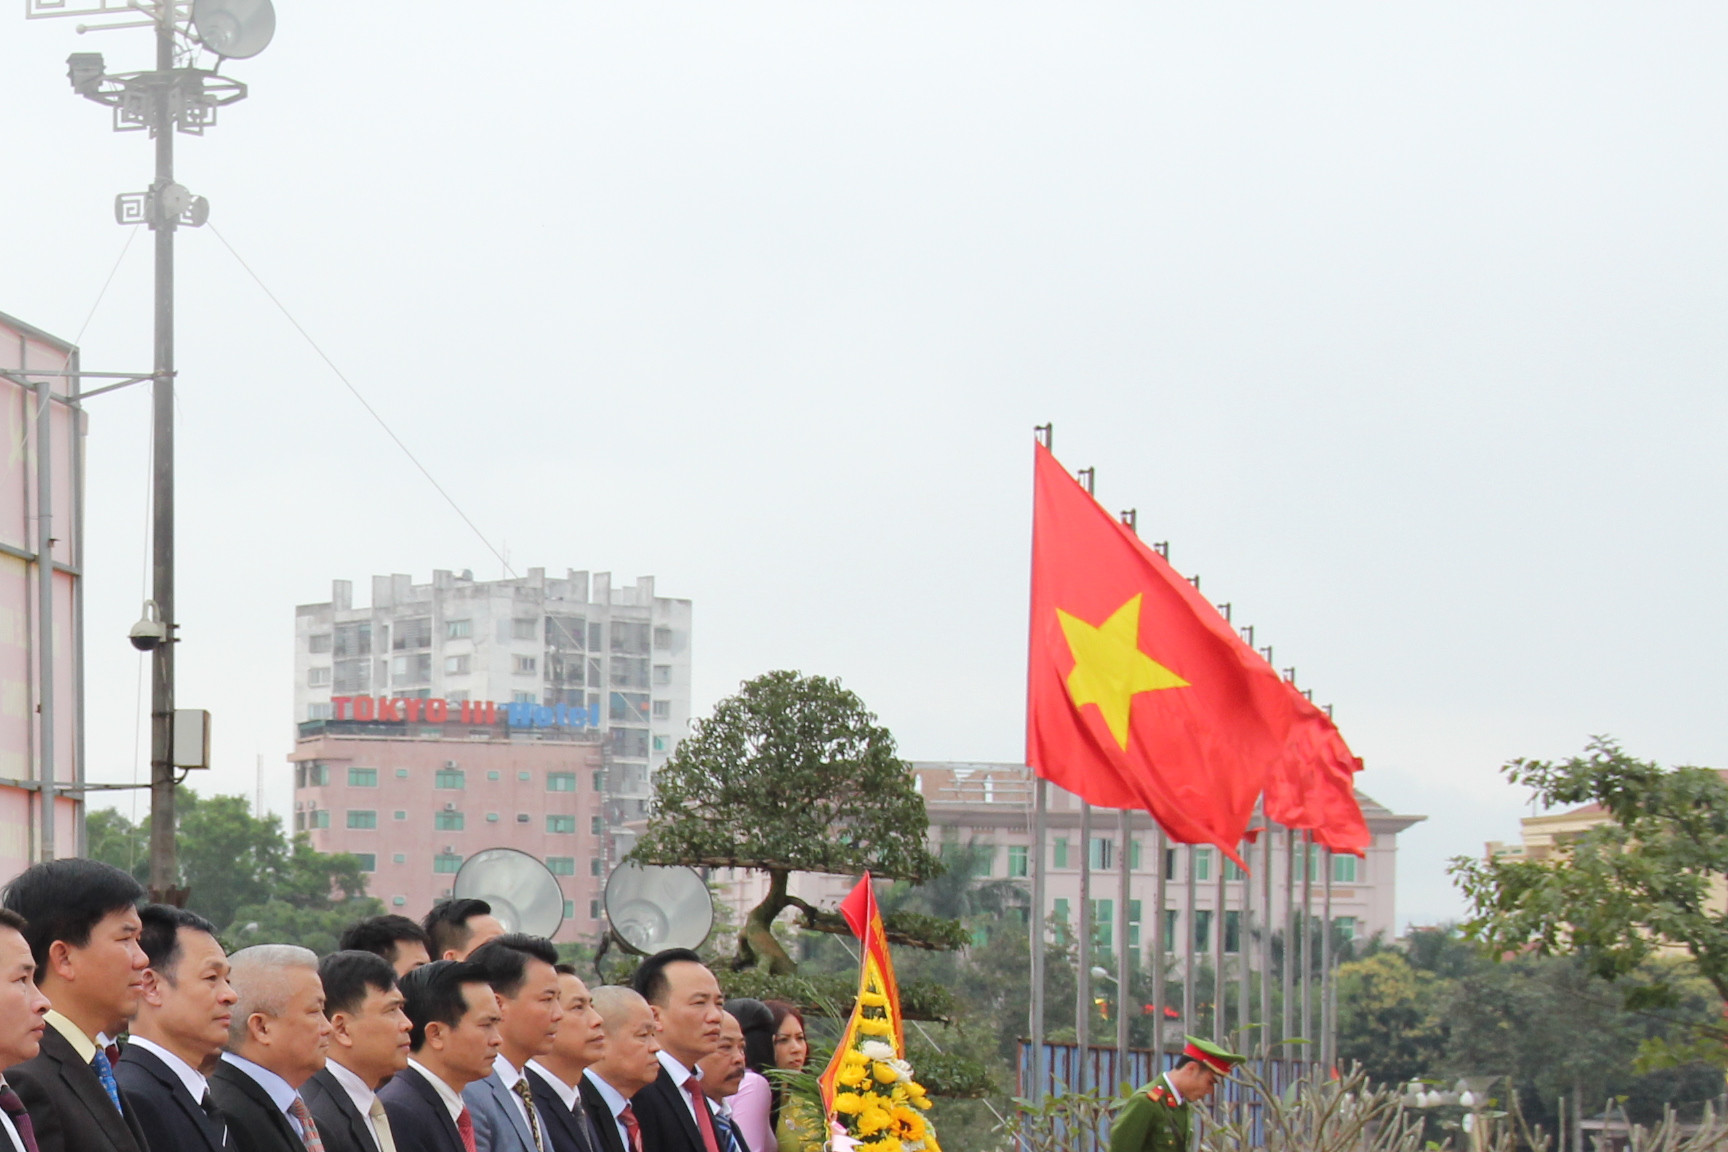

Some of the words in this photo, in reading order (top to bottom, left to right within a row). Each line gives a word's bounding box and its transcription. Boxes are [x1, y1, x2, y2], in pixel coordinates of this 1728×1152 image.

[331, 695, 448, 723] TOKYO
[461, 700, 495, 724] III
[505, 702, 600, 728] Hotel
